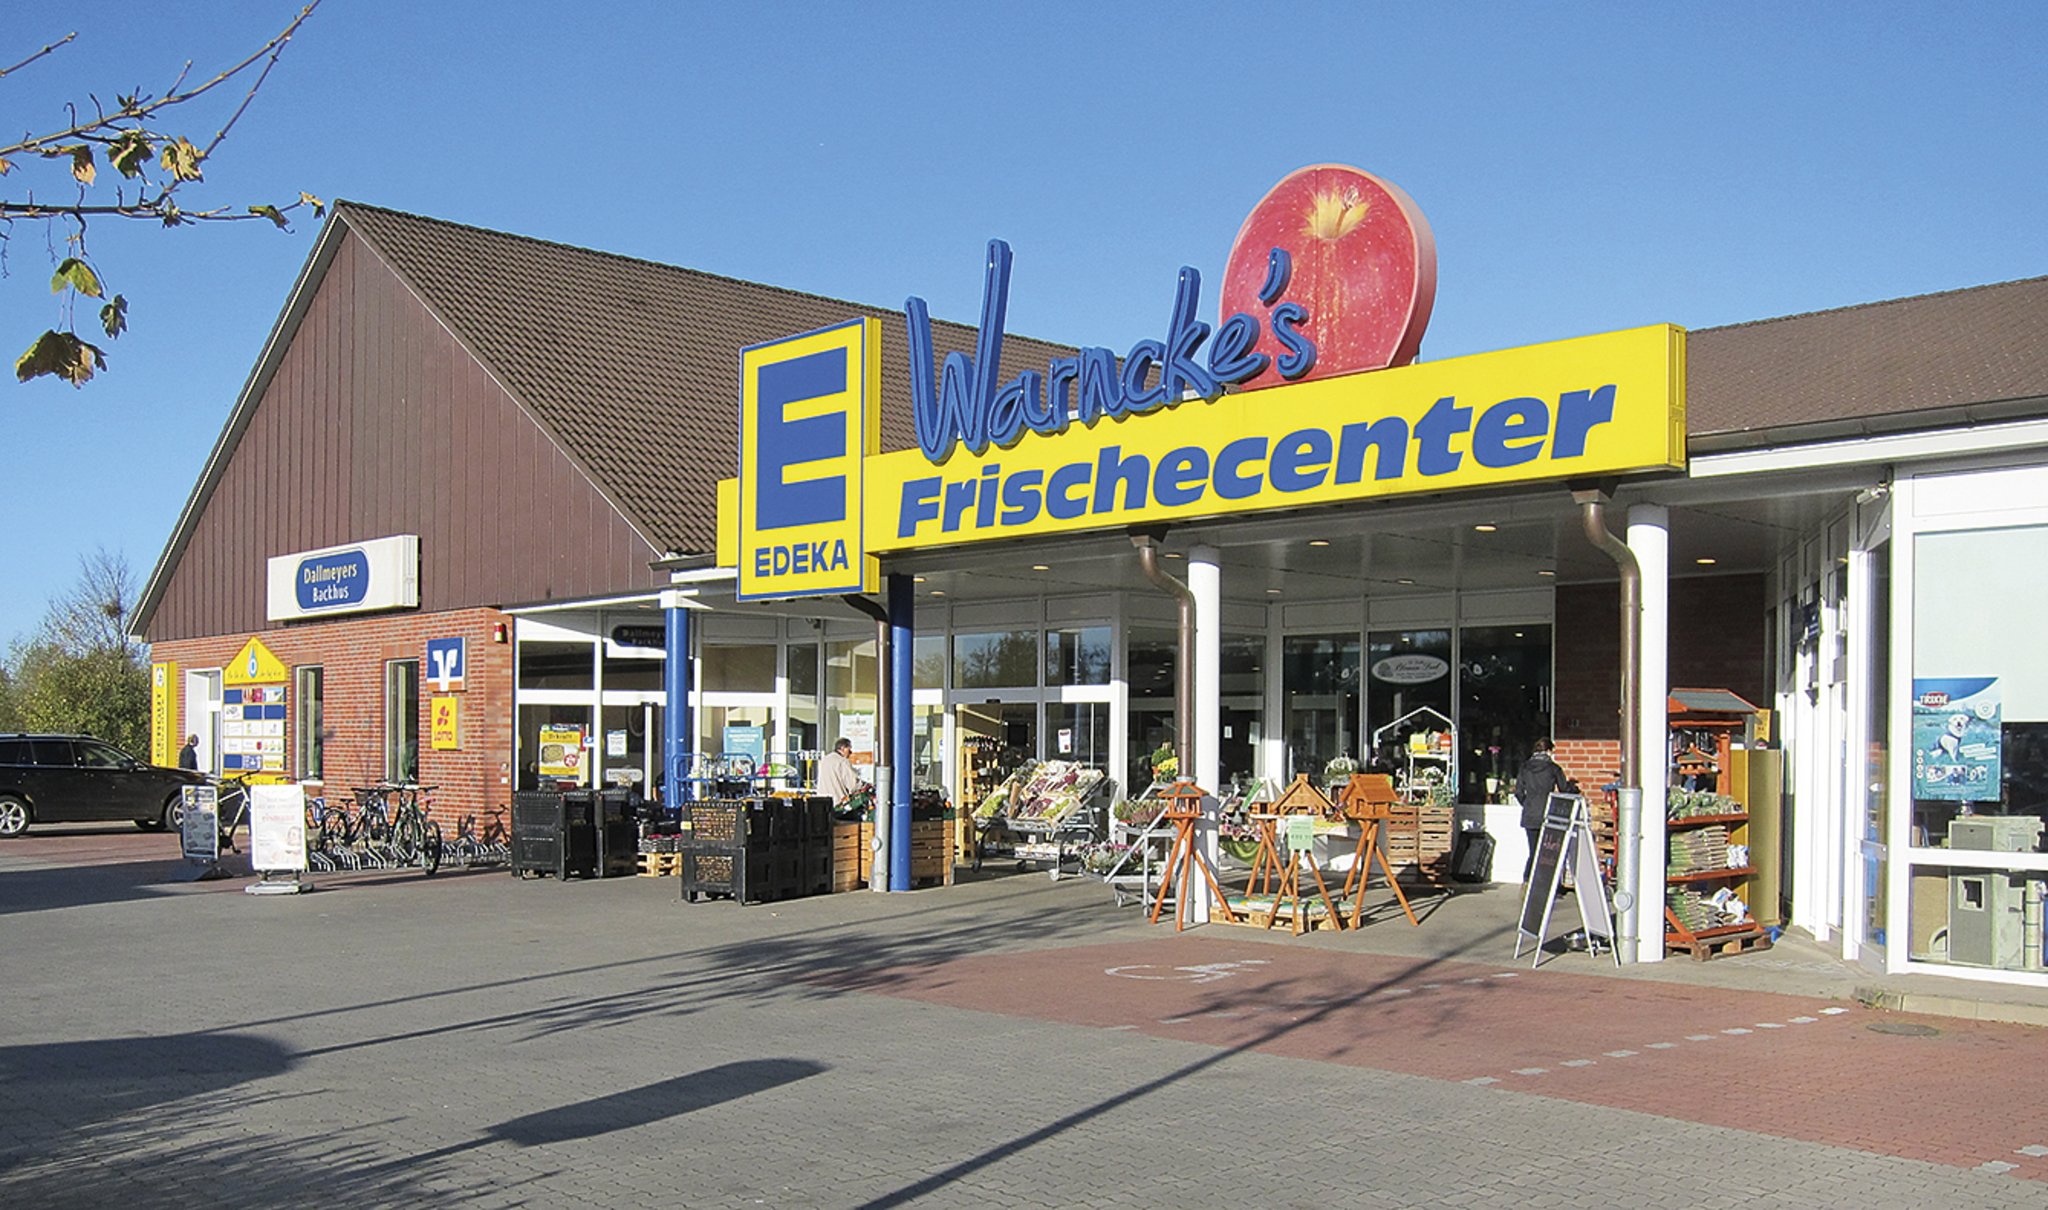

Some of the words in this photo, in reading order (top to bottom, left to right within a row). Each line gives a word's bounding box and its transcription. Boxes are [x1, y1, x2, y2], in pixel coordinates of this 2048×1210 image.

[904, 238, 1317, 466] Warncke's
[755, 346, 848, 531] E
[897, 383, 1616, 539] Frischecenter
[303, 563, 358, 584] Dallmeyers
[312, 584, 349, 603] Backhus
[755, 539, 849, 578] EDEKA
